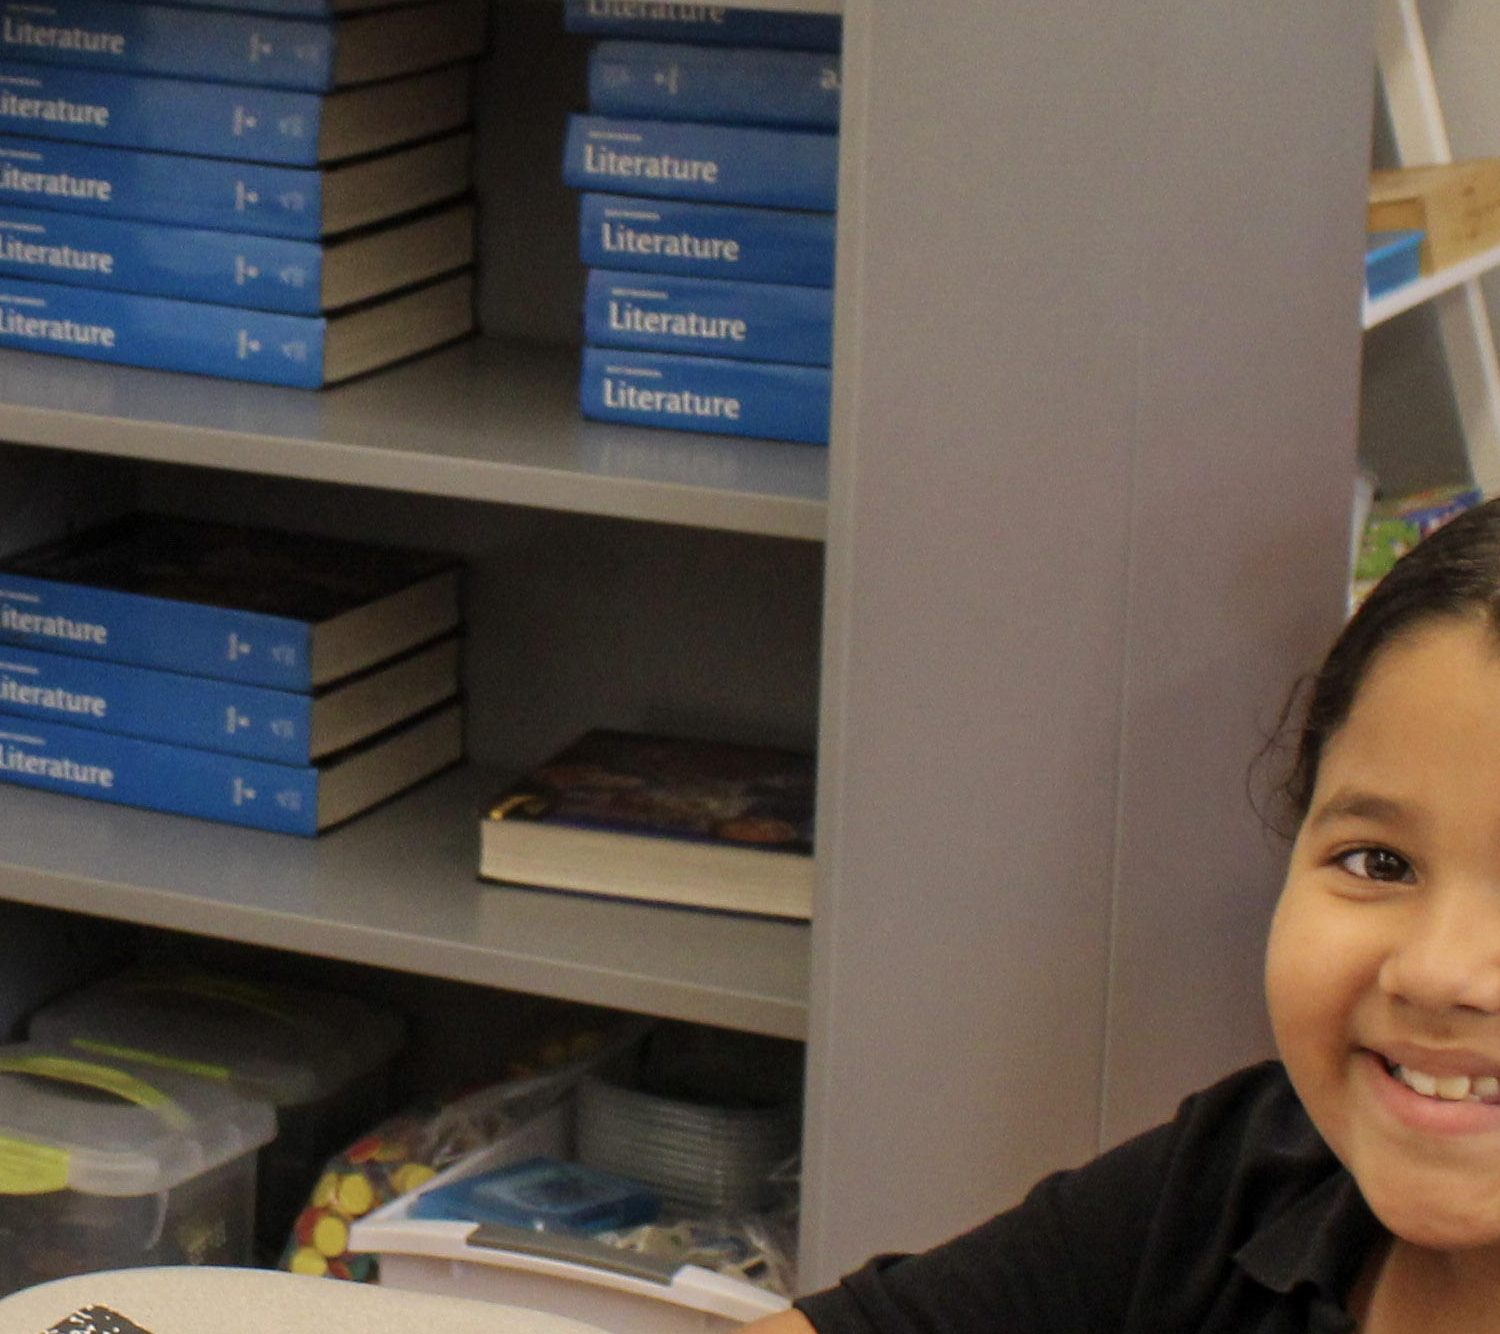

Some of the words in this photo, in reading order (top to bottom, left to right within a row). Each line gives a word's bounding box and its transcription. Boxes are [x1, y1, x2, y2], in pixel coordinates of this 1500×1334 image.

[2, 18, 126, 55] Literature
[584, 143, 719, 183] Literature
[602, 222, 740, 262] Literature
[608, 299, 747, 342] Literature
[603, 378, 741, 420] Literature
